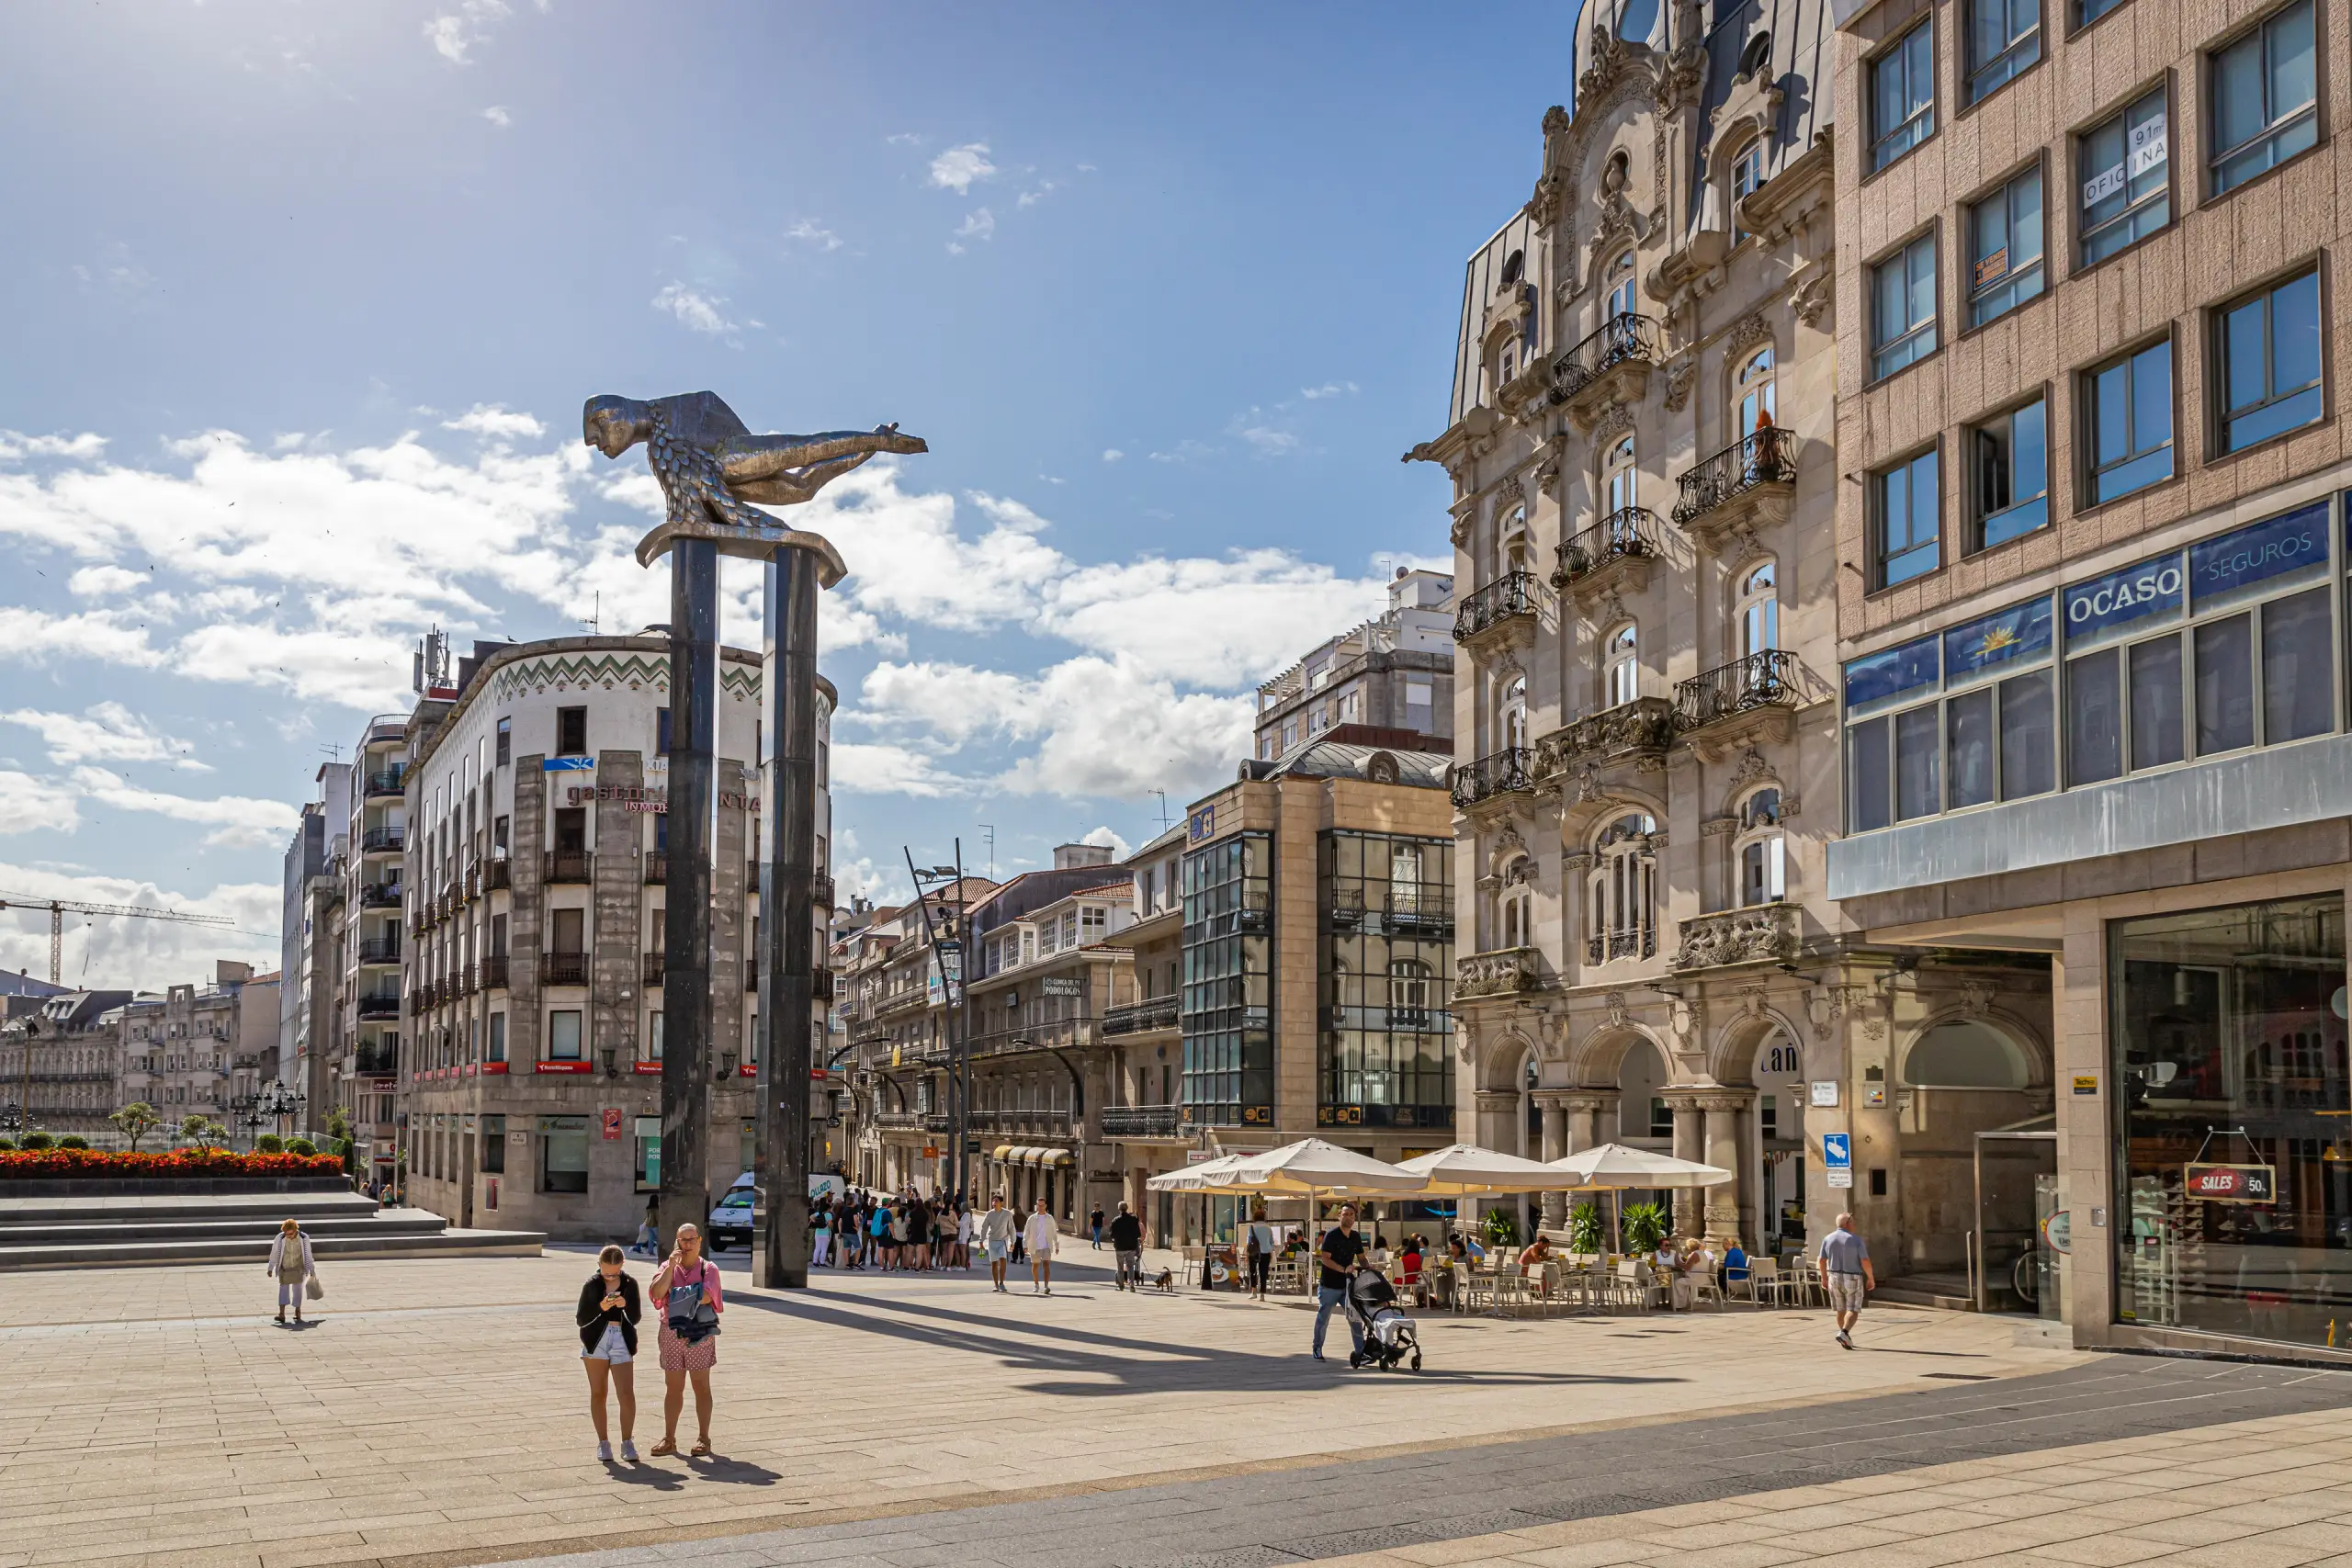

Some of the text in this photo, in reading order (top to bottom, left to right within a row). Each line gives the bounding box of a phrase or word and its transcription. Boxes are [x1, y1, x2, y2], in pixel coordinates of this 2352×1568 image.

[2069, 531, 2312, 623] OCASO SEGUROS
[1045, 986, 1080, 996] PODOLOGOS
[2201, 1175, 2233, 1190] SALES
